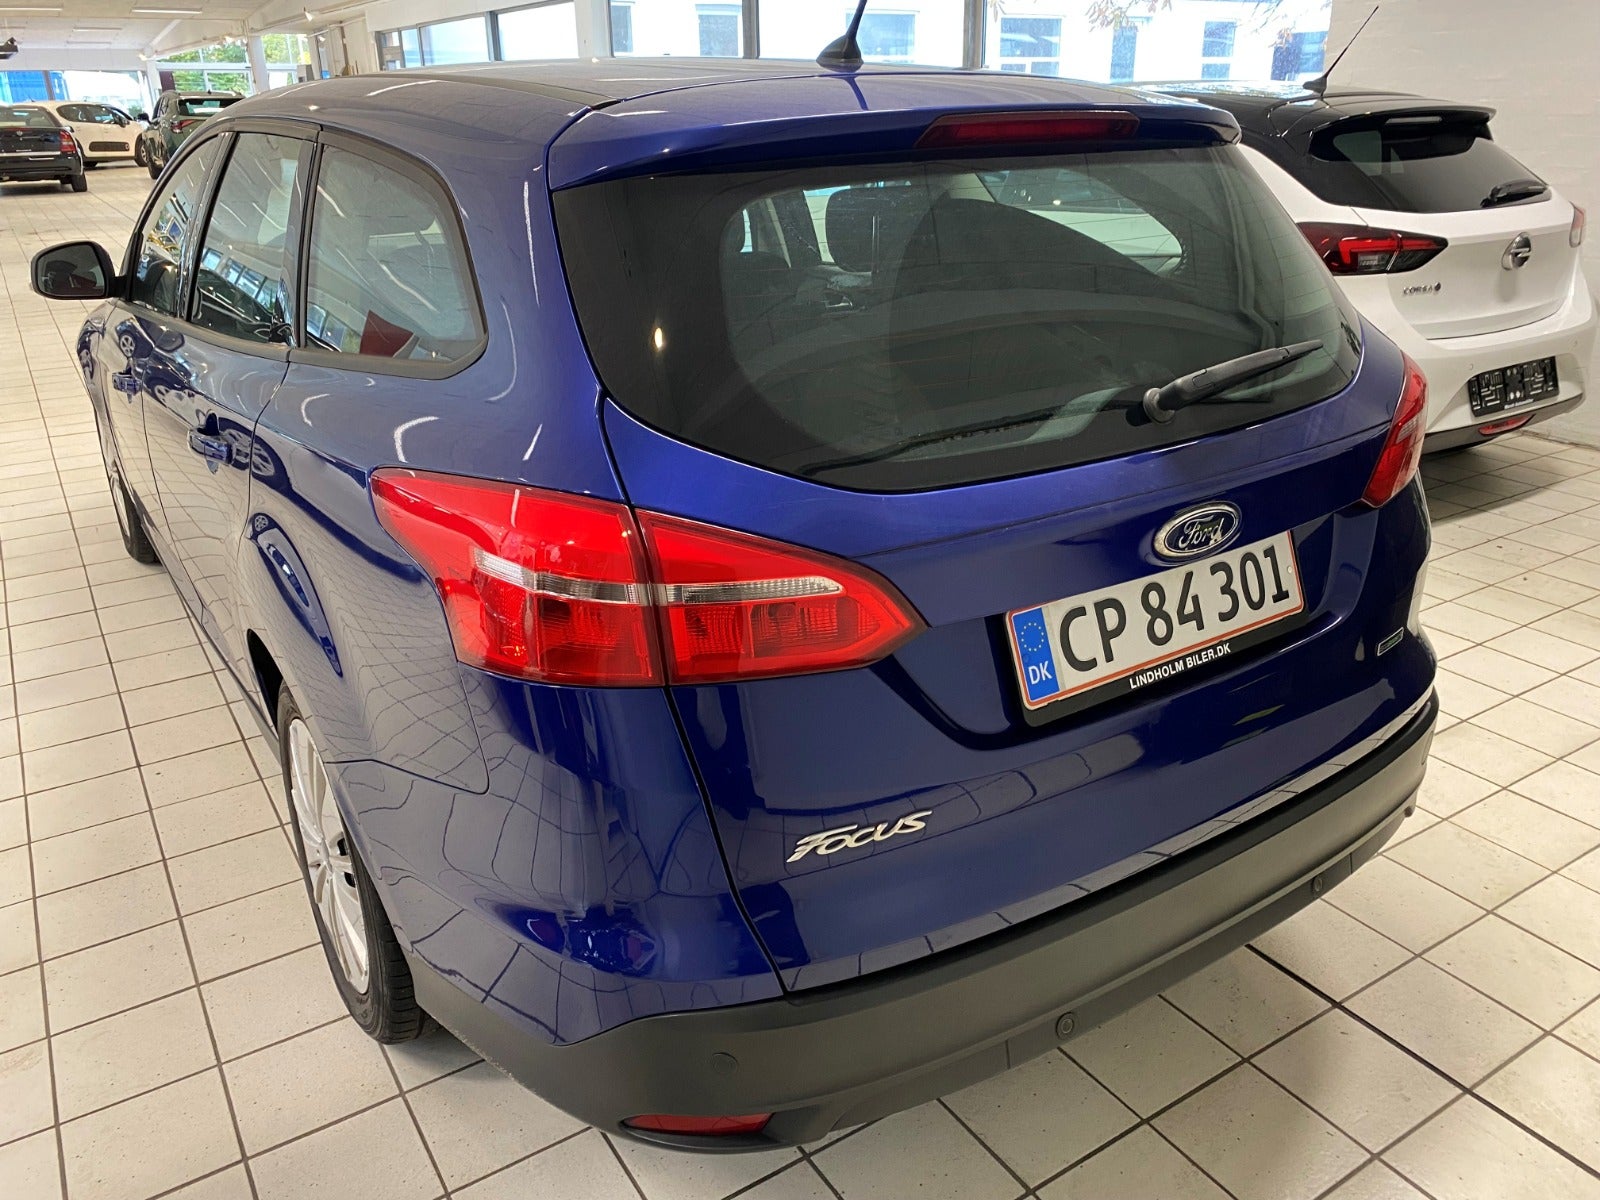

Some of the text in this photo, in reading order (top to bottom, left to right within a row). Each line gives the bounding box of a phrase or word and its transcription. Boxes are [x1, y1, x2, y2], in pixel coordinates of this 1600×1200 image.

[1178, 515, 1223, 548] Ford
[1060, 546, 1289, 671] CP 84 301
[1029, 661, 1052, 684] DK
[1129, 643, 1231, 689] LINDHOLM BILER.DK
